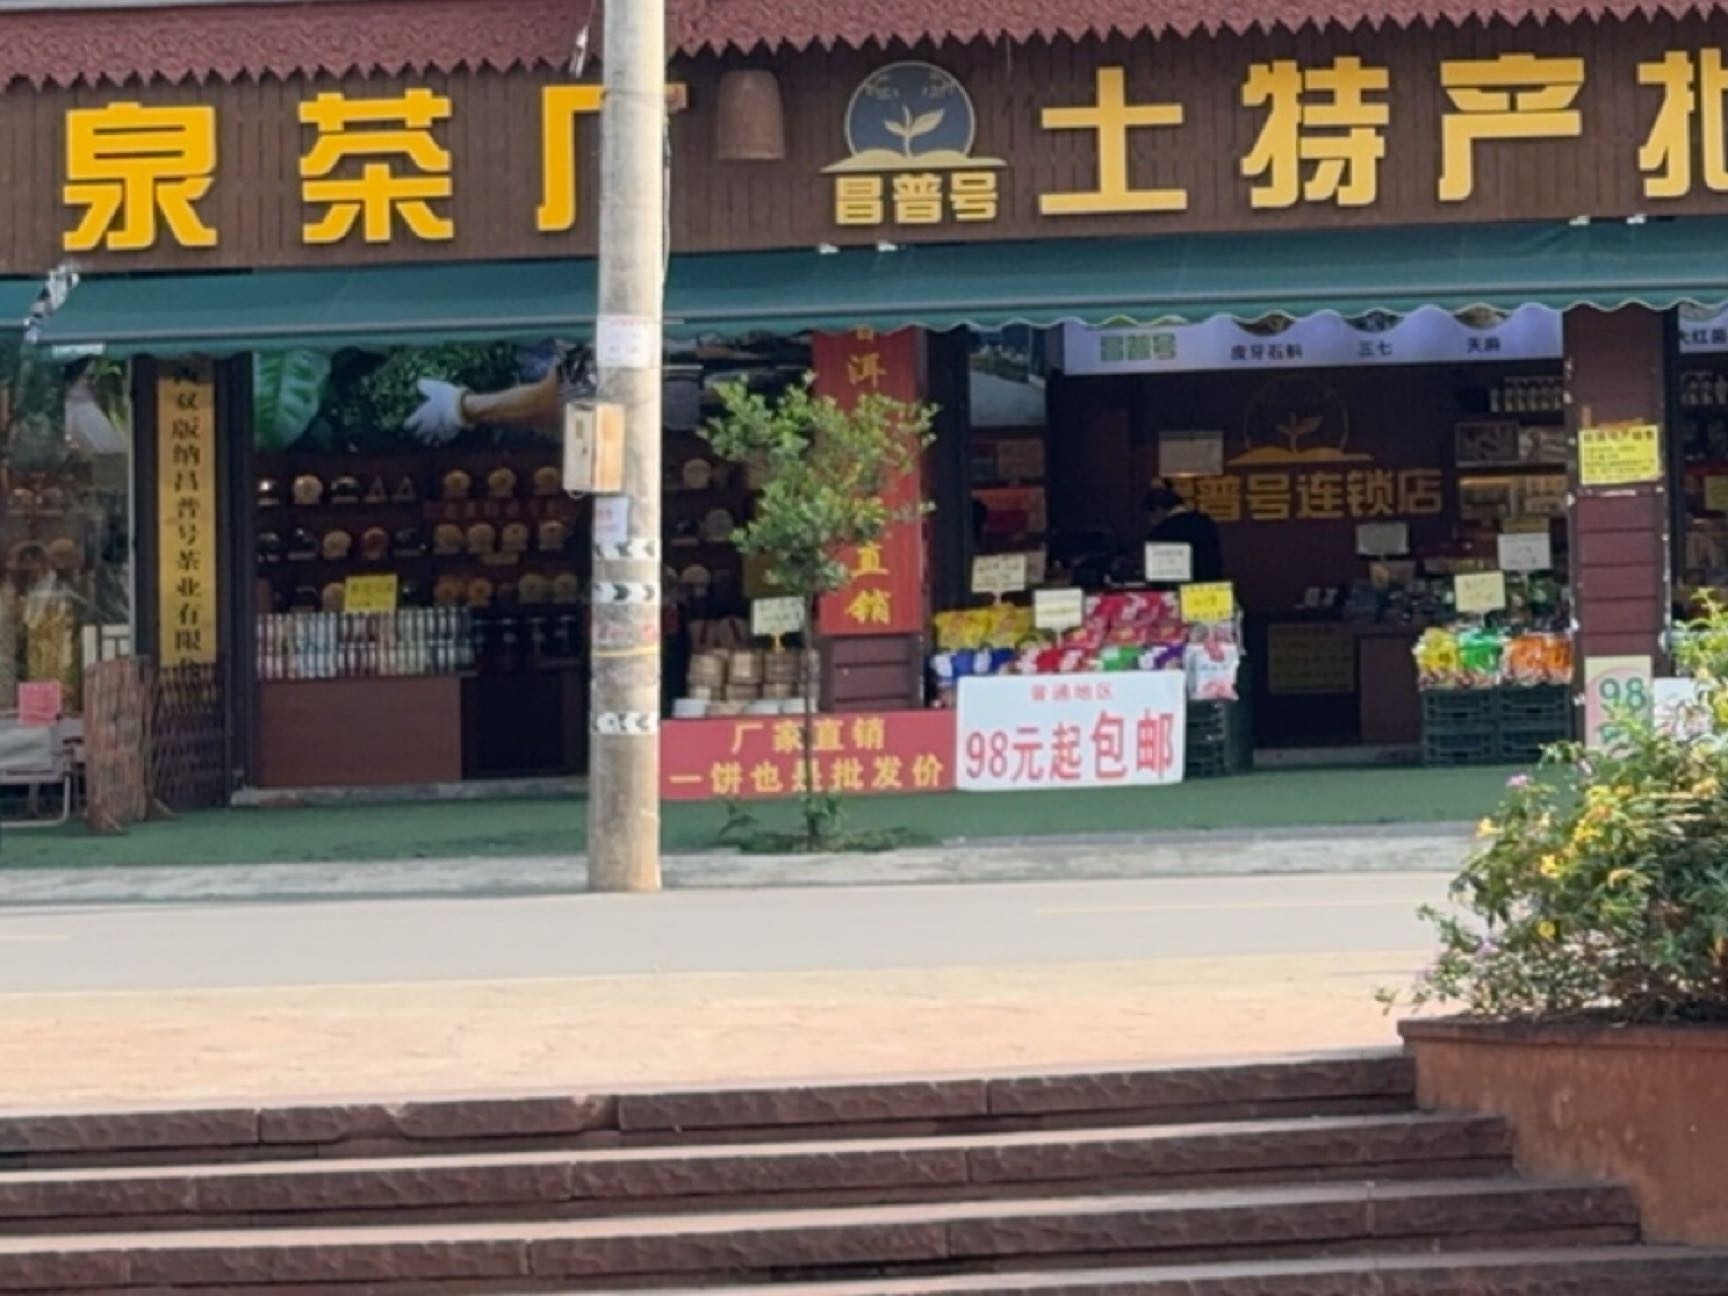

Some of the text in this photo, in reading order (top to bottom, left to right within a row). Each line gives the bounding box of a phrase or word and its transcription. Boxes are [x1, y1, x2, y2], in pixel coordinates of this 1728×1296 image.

[835, 171, 999, 225] 昌普号
[731, 717, 886, 754] 厂家直销
[965, 709, 1175, 783] 98元起包邮
